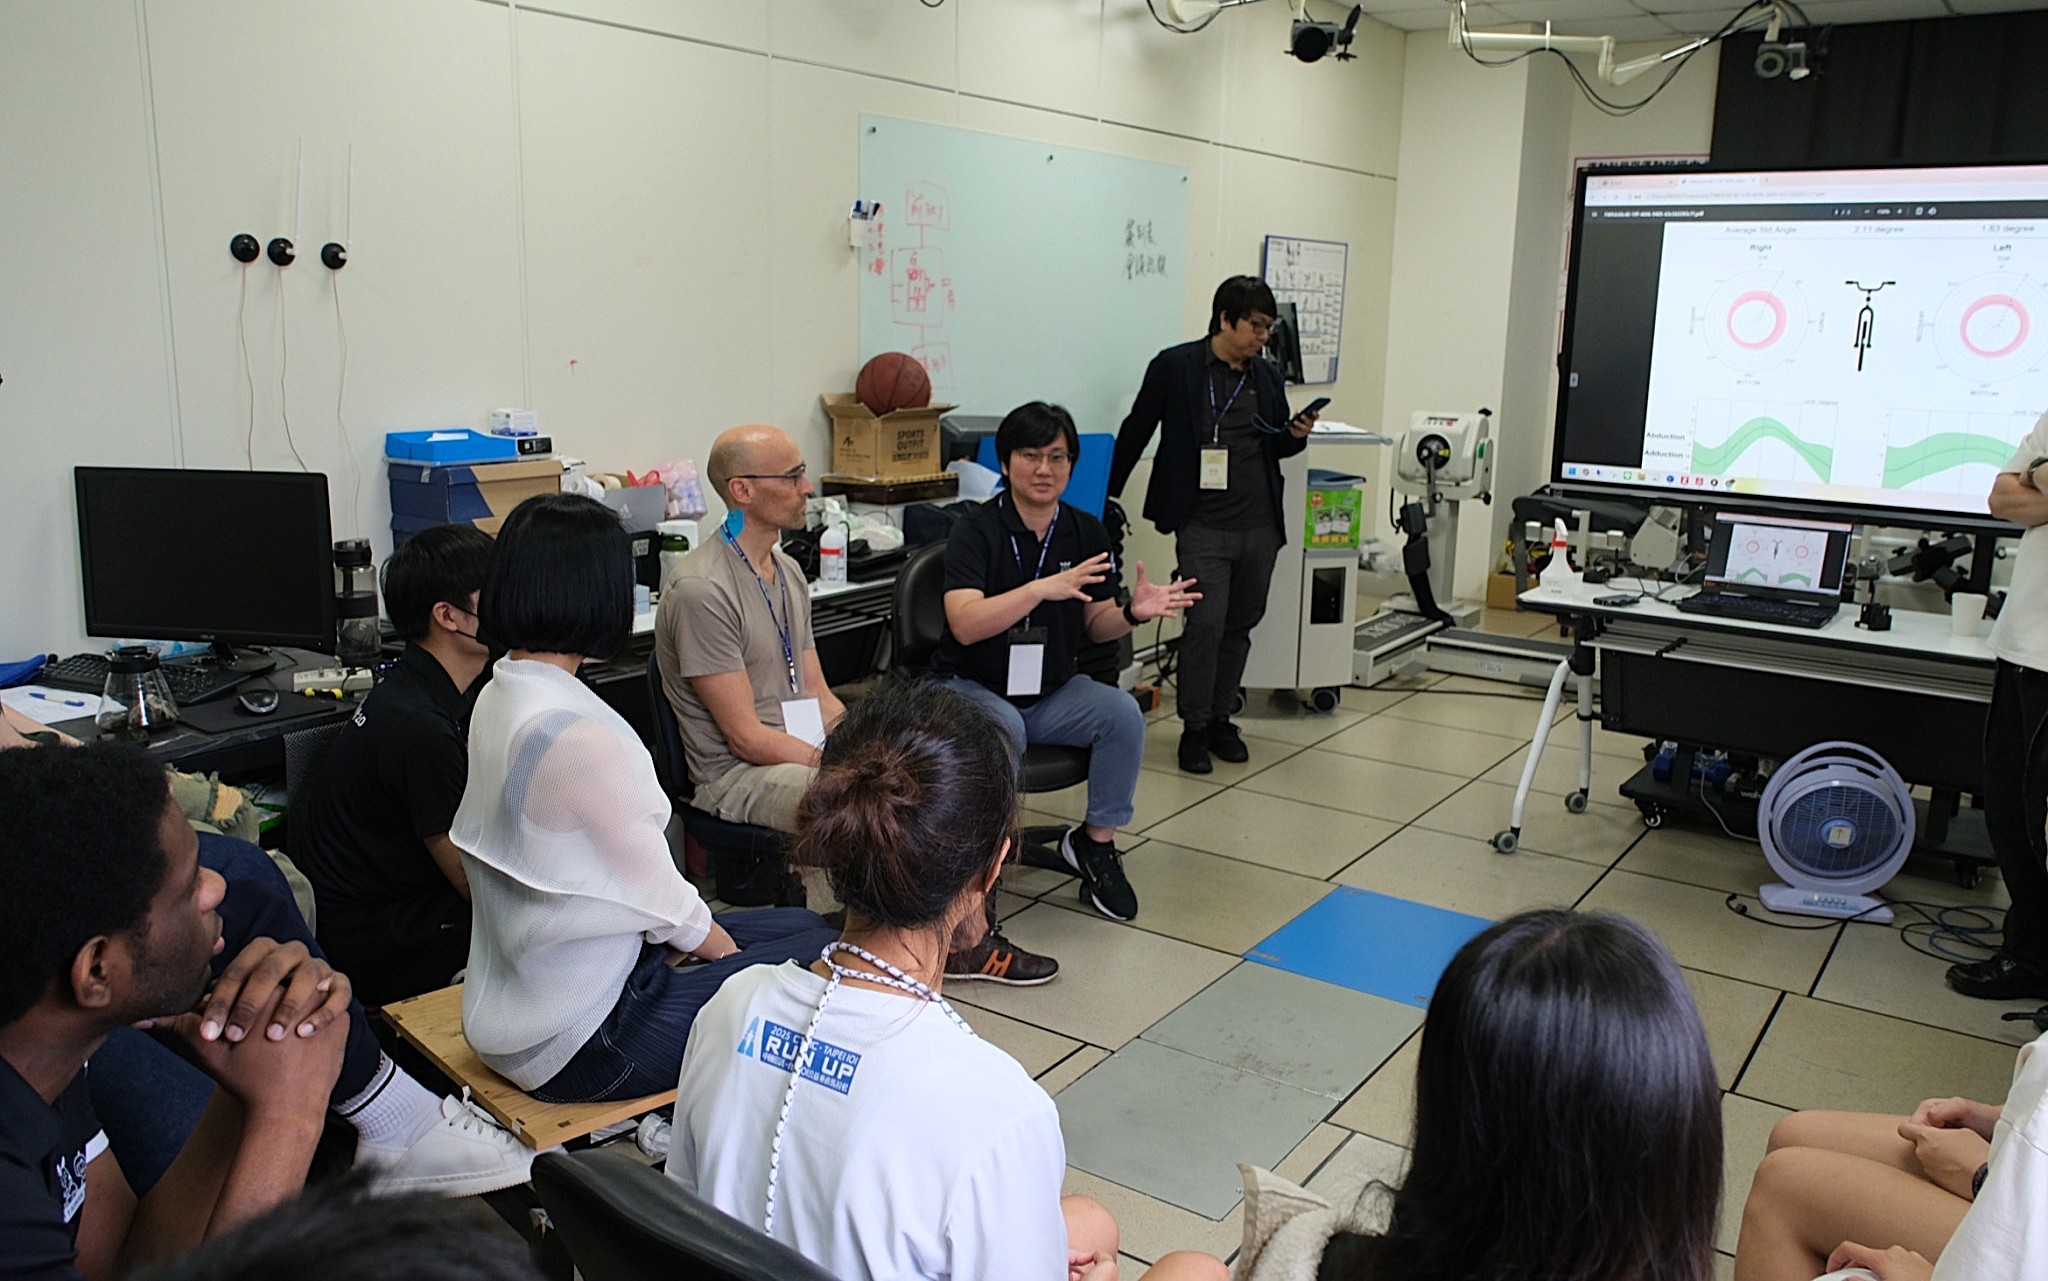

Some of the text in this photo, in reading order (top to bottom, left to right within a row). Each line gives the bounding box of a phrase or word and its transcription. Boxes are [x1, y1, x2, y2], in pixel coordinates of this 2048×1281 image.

[1725, 226, 1757, 236] Average
[1774, 225, 1798, 236] Angle
[1874, 225, 1904, 235] degree
[2003, 224, 2036, 234] degree
[1749, 244, 1773, 253] Right
[1993, 243, 2012, 252] Left
[897, 429, 924, 440] SPORTS
[1646, 431, 1685, 441] Abduction
[896, 440, 924, 451] OUTFIT
[1644, 449, 1684, 459] Adduction
[770, 1026, 792, 1041] 2025
[793, 1034, 819, 1052] CC
[823, 1045, 847, 1061] TAIPEI
[765, 1035, 815, 1069] RUN
[821, 1056, 854, 1080] UP
